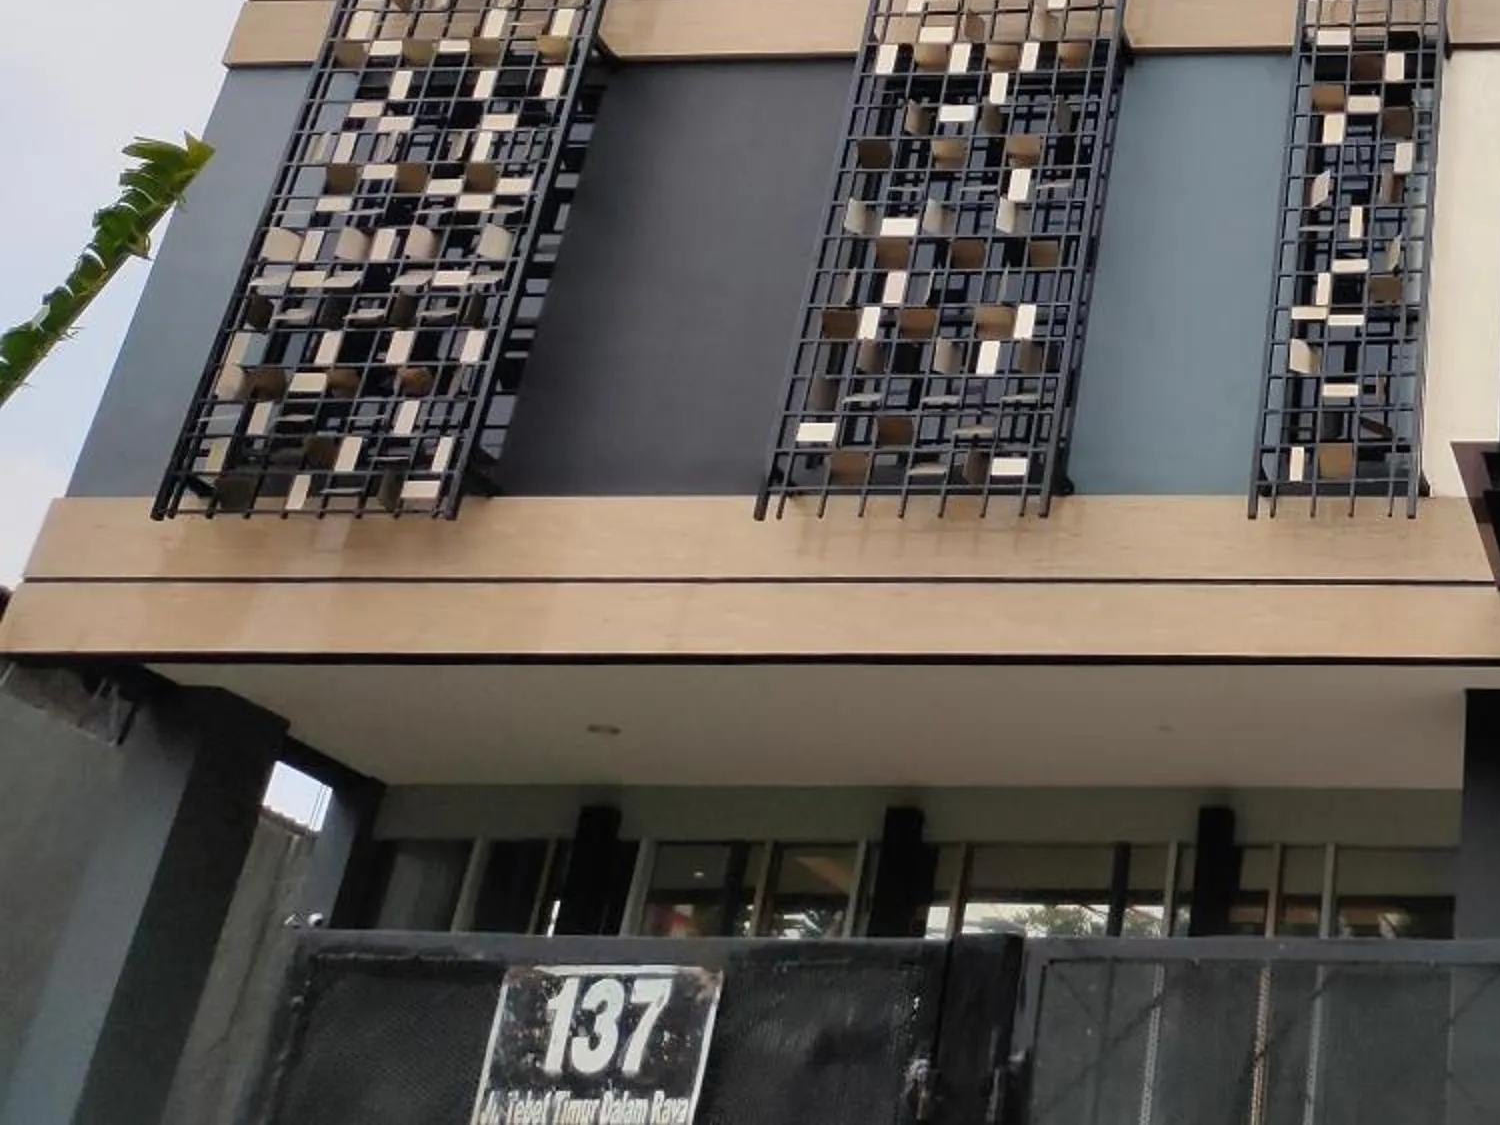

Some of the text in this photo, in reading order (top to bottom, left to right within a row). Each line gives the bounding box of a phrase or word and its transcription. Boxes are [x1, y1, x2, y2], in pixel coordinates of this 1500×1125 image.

[543, 977, 673, 1075] 137
[552, 1090, 600, 1125] Timur
[599, 1090, 648, 1125] Dalam
[650, 1090, 689, 1125] Raya
